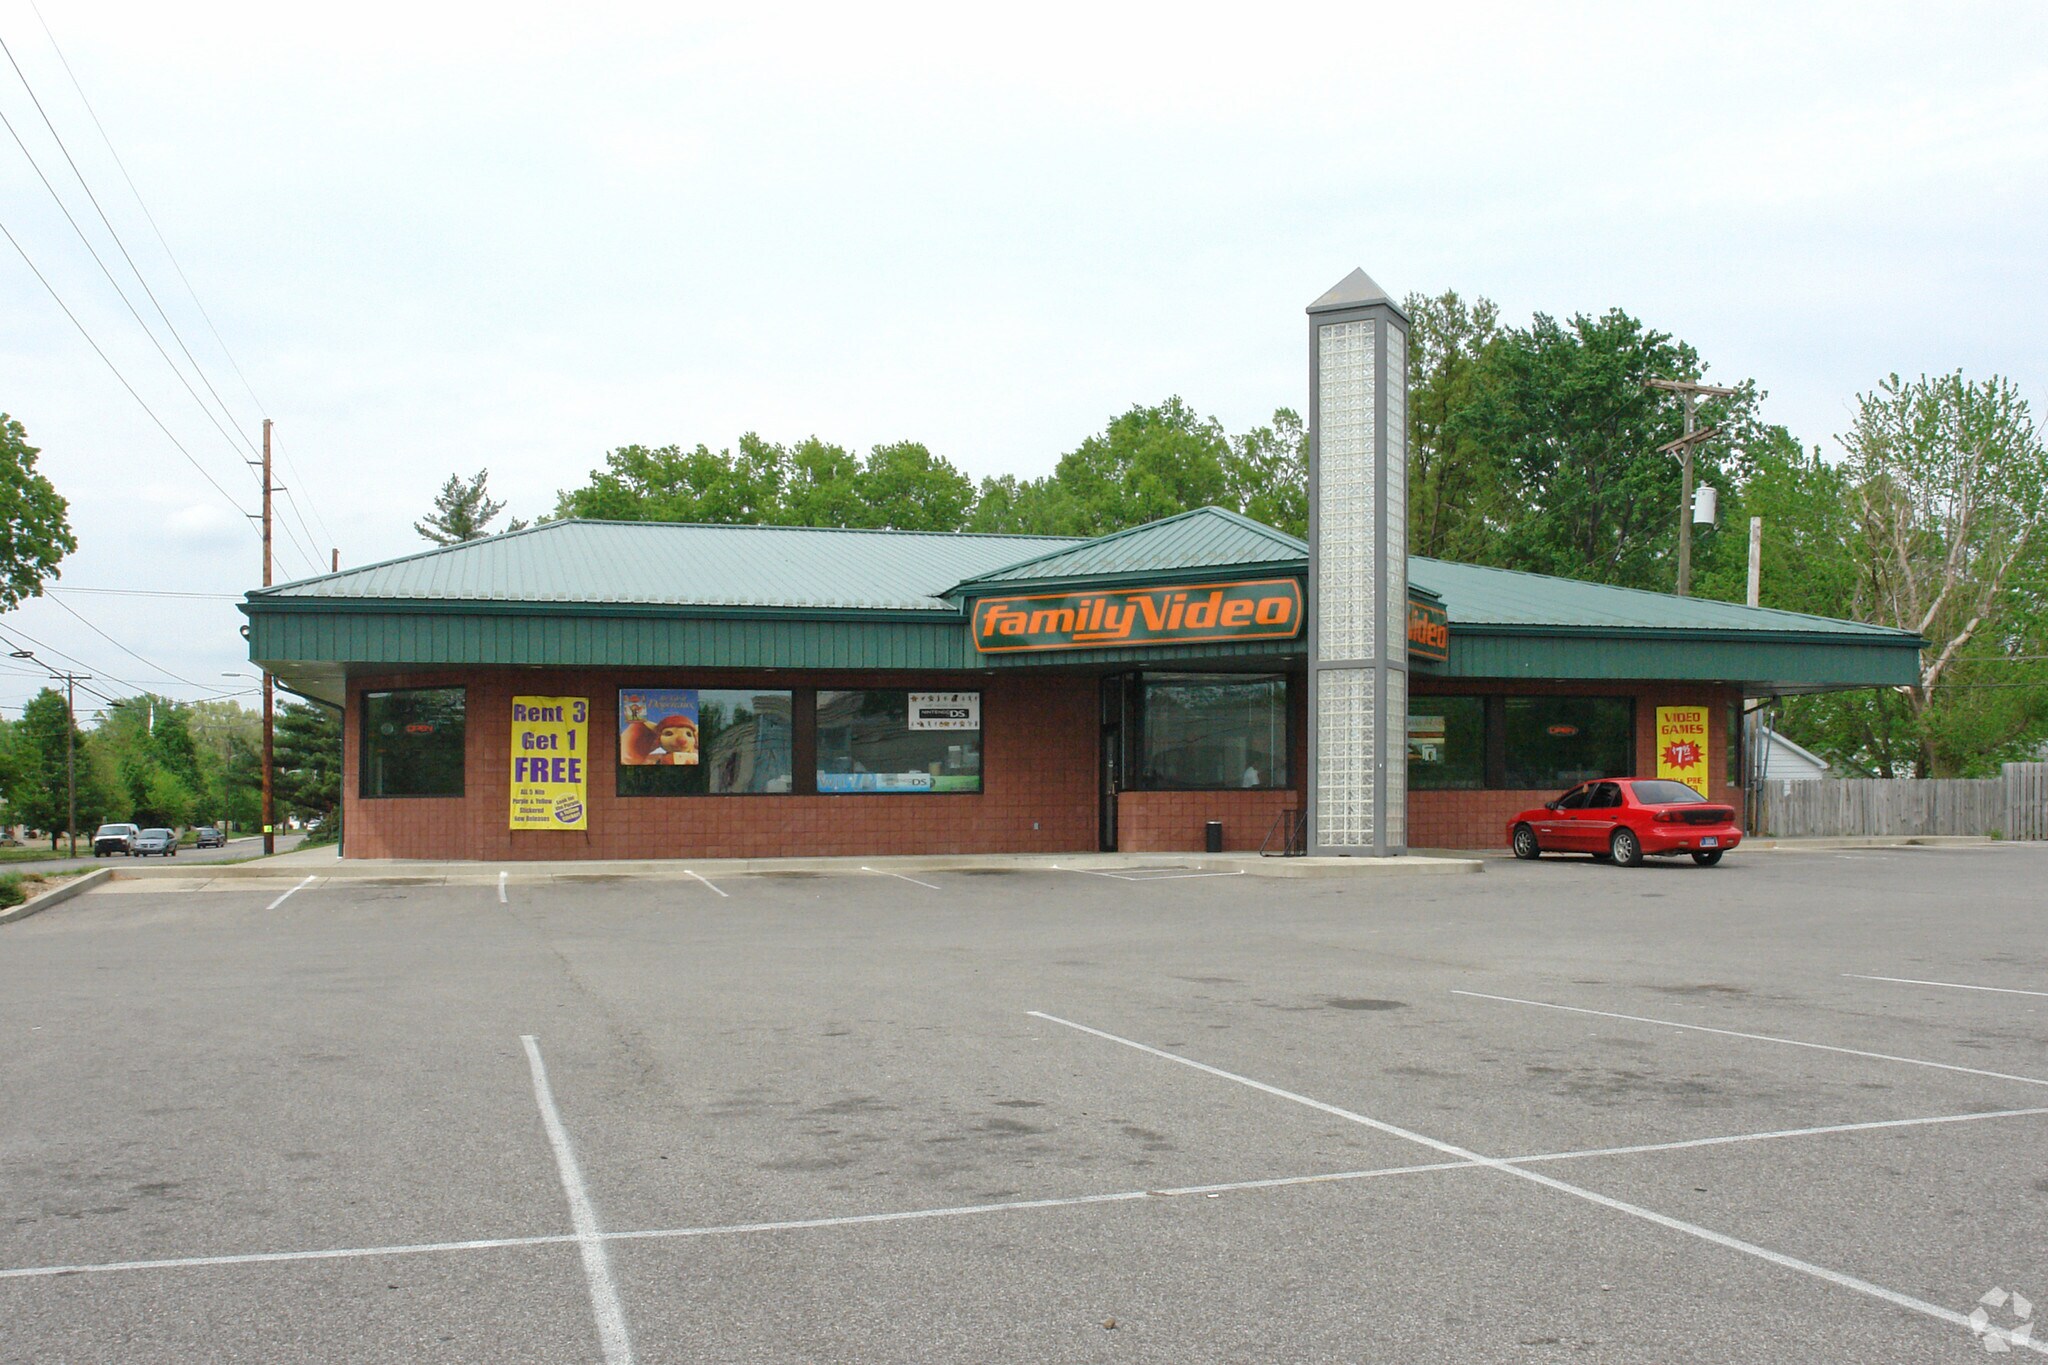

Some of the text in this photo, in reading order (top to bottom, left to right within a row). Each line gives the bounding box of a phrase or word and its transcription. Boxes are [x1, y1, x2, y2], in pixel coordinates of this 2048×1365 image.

[514, 702, 586, 723] Rent 3
[1665, 712, 1700, 722] VIDEO
[522, 729, 576, 750] Get 1
[1662, 724, 1704, 734] GAMES
[515, 757, 581, 783] FREE
